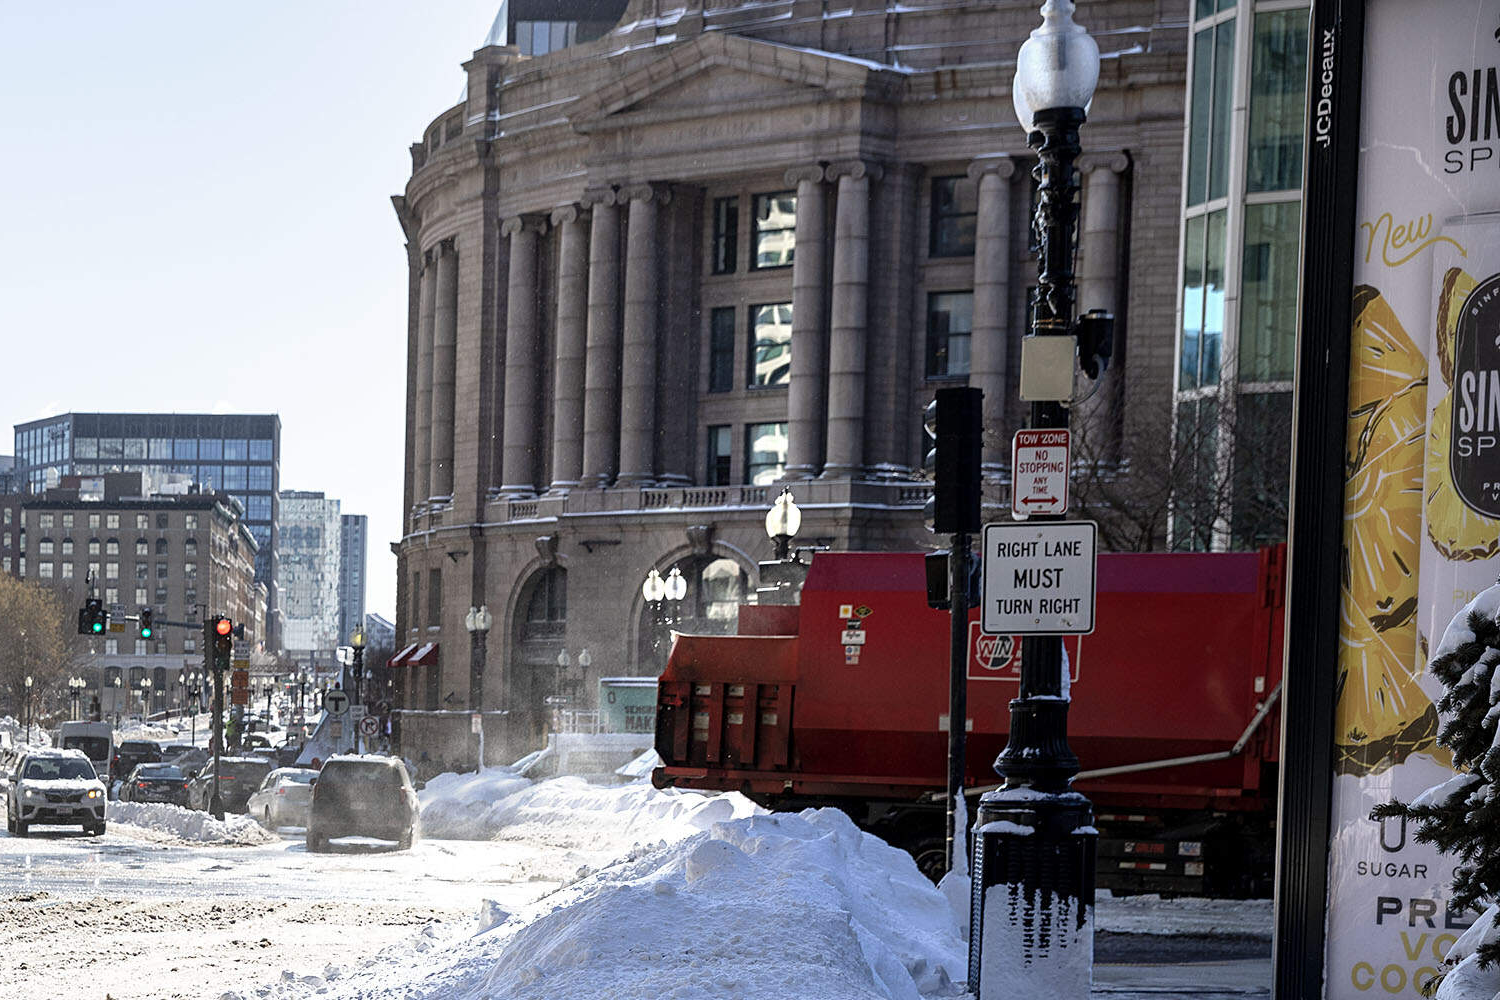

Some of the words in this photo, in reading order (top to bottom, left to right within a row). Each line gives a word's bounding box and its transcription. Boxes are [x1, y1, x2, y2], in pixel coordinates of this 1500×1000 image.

[1316, 28, 1335, 149] JCDecaux
[1444, 147, 1500, 174] SP
[1360, 212, 1433, 268] New
[1018, 433, 1039, 445] TOW
[1041, 433, 1067, 444] ZONE
[1035, 449, 1049, 461] NO
[1019, 462, 1064, 474] STOPPING
[1033, 476, 1048, 485] ANY
[1033, 486, 1048, 495] TIME
[997, 541, 1038, 558] RIGHT
[1044, 541, 1082, 557] LANE
[1013, 568, 1064, 589] MUST
[996, 599, 1033, 615] TURN
[1039, 599, 1081, 615] RIGHT
[1357, 861, 1428, 879] SUGAR
